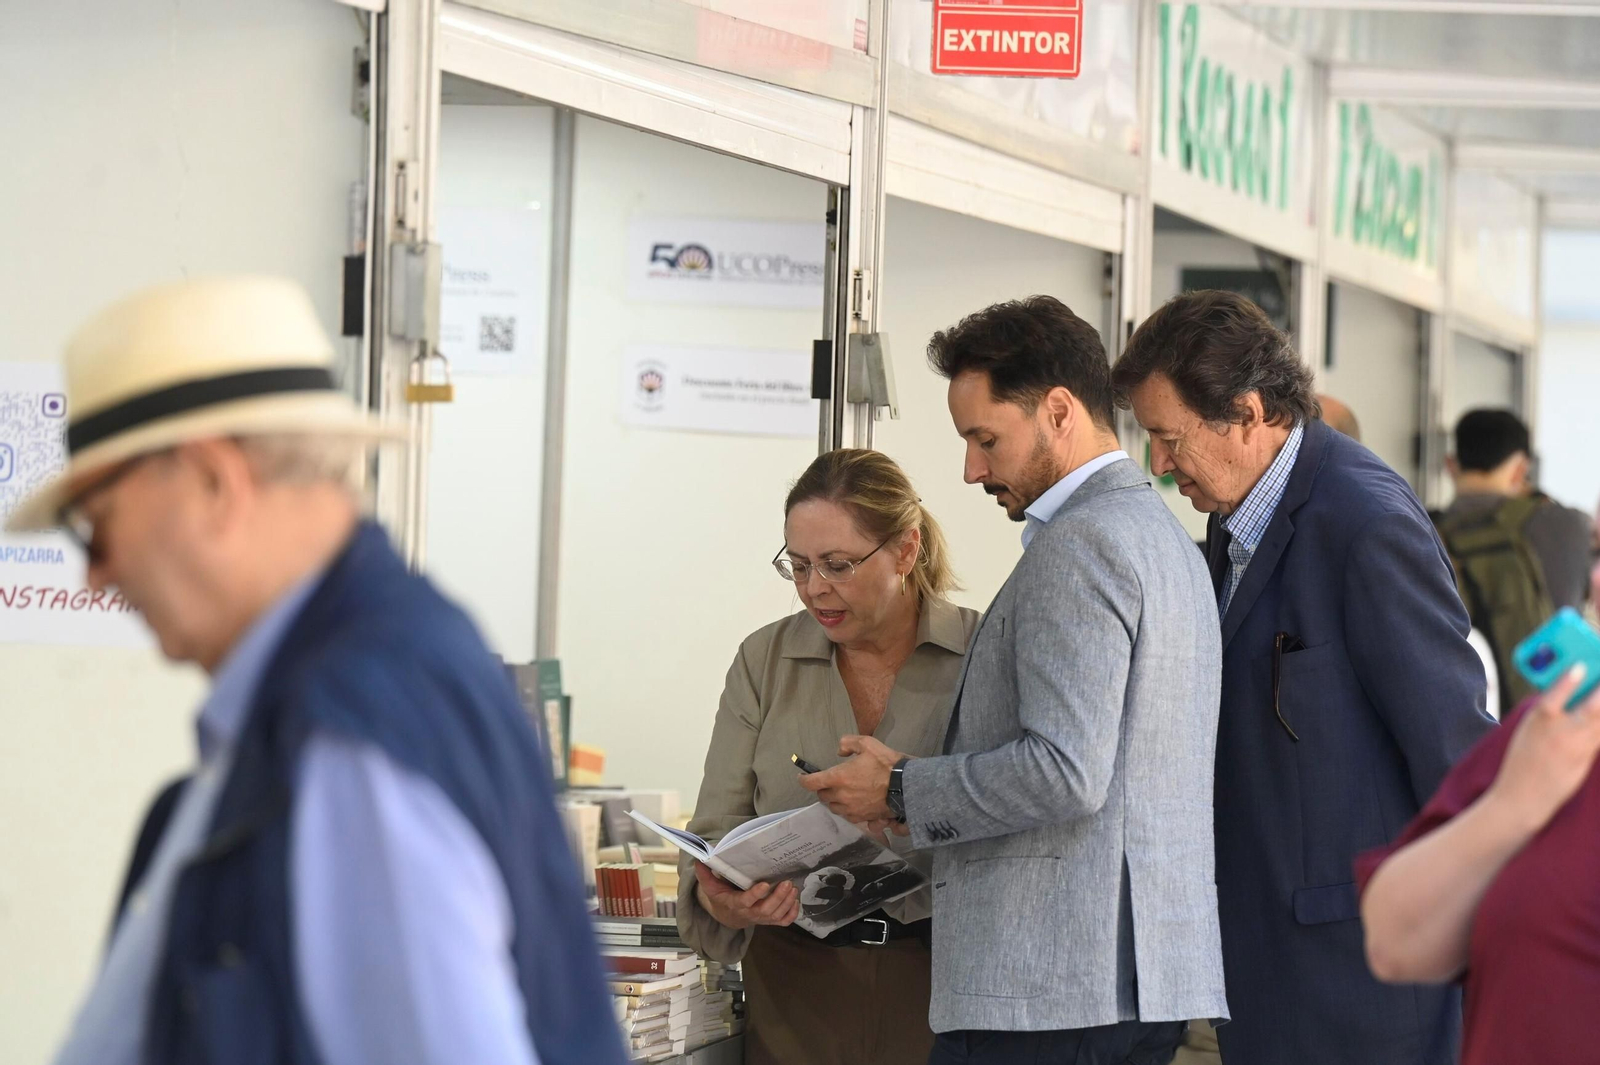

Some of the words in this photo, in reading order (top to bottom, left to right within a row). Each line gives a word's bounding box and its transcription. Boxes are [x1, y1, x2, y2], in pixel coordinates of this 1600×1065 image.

[943, 29, 1070, 55] EXTINTOR
[783, 841, 812, 858] Anestesia
[651, 961, 658, 970] 32
